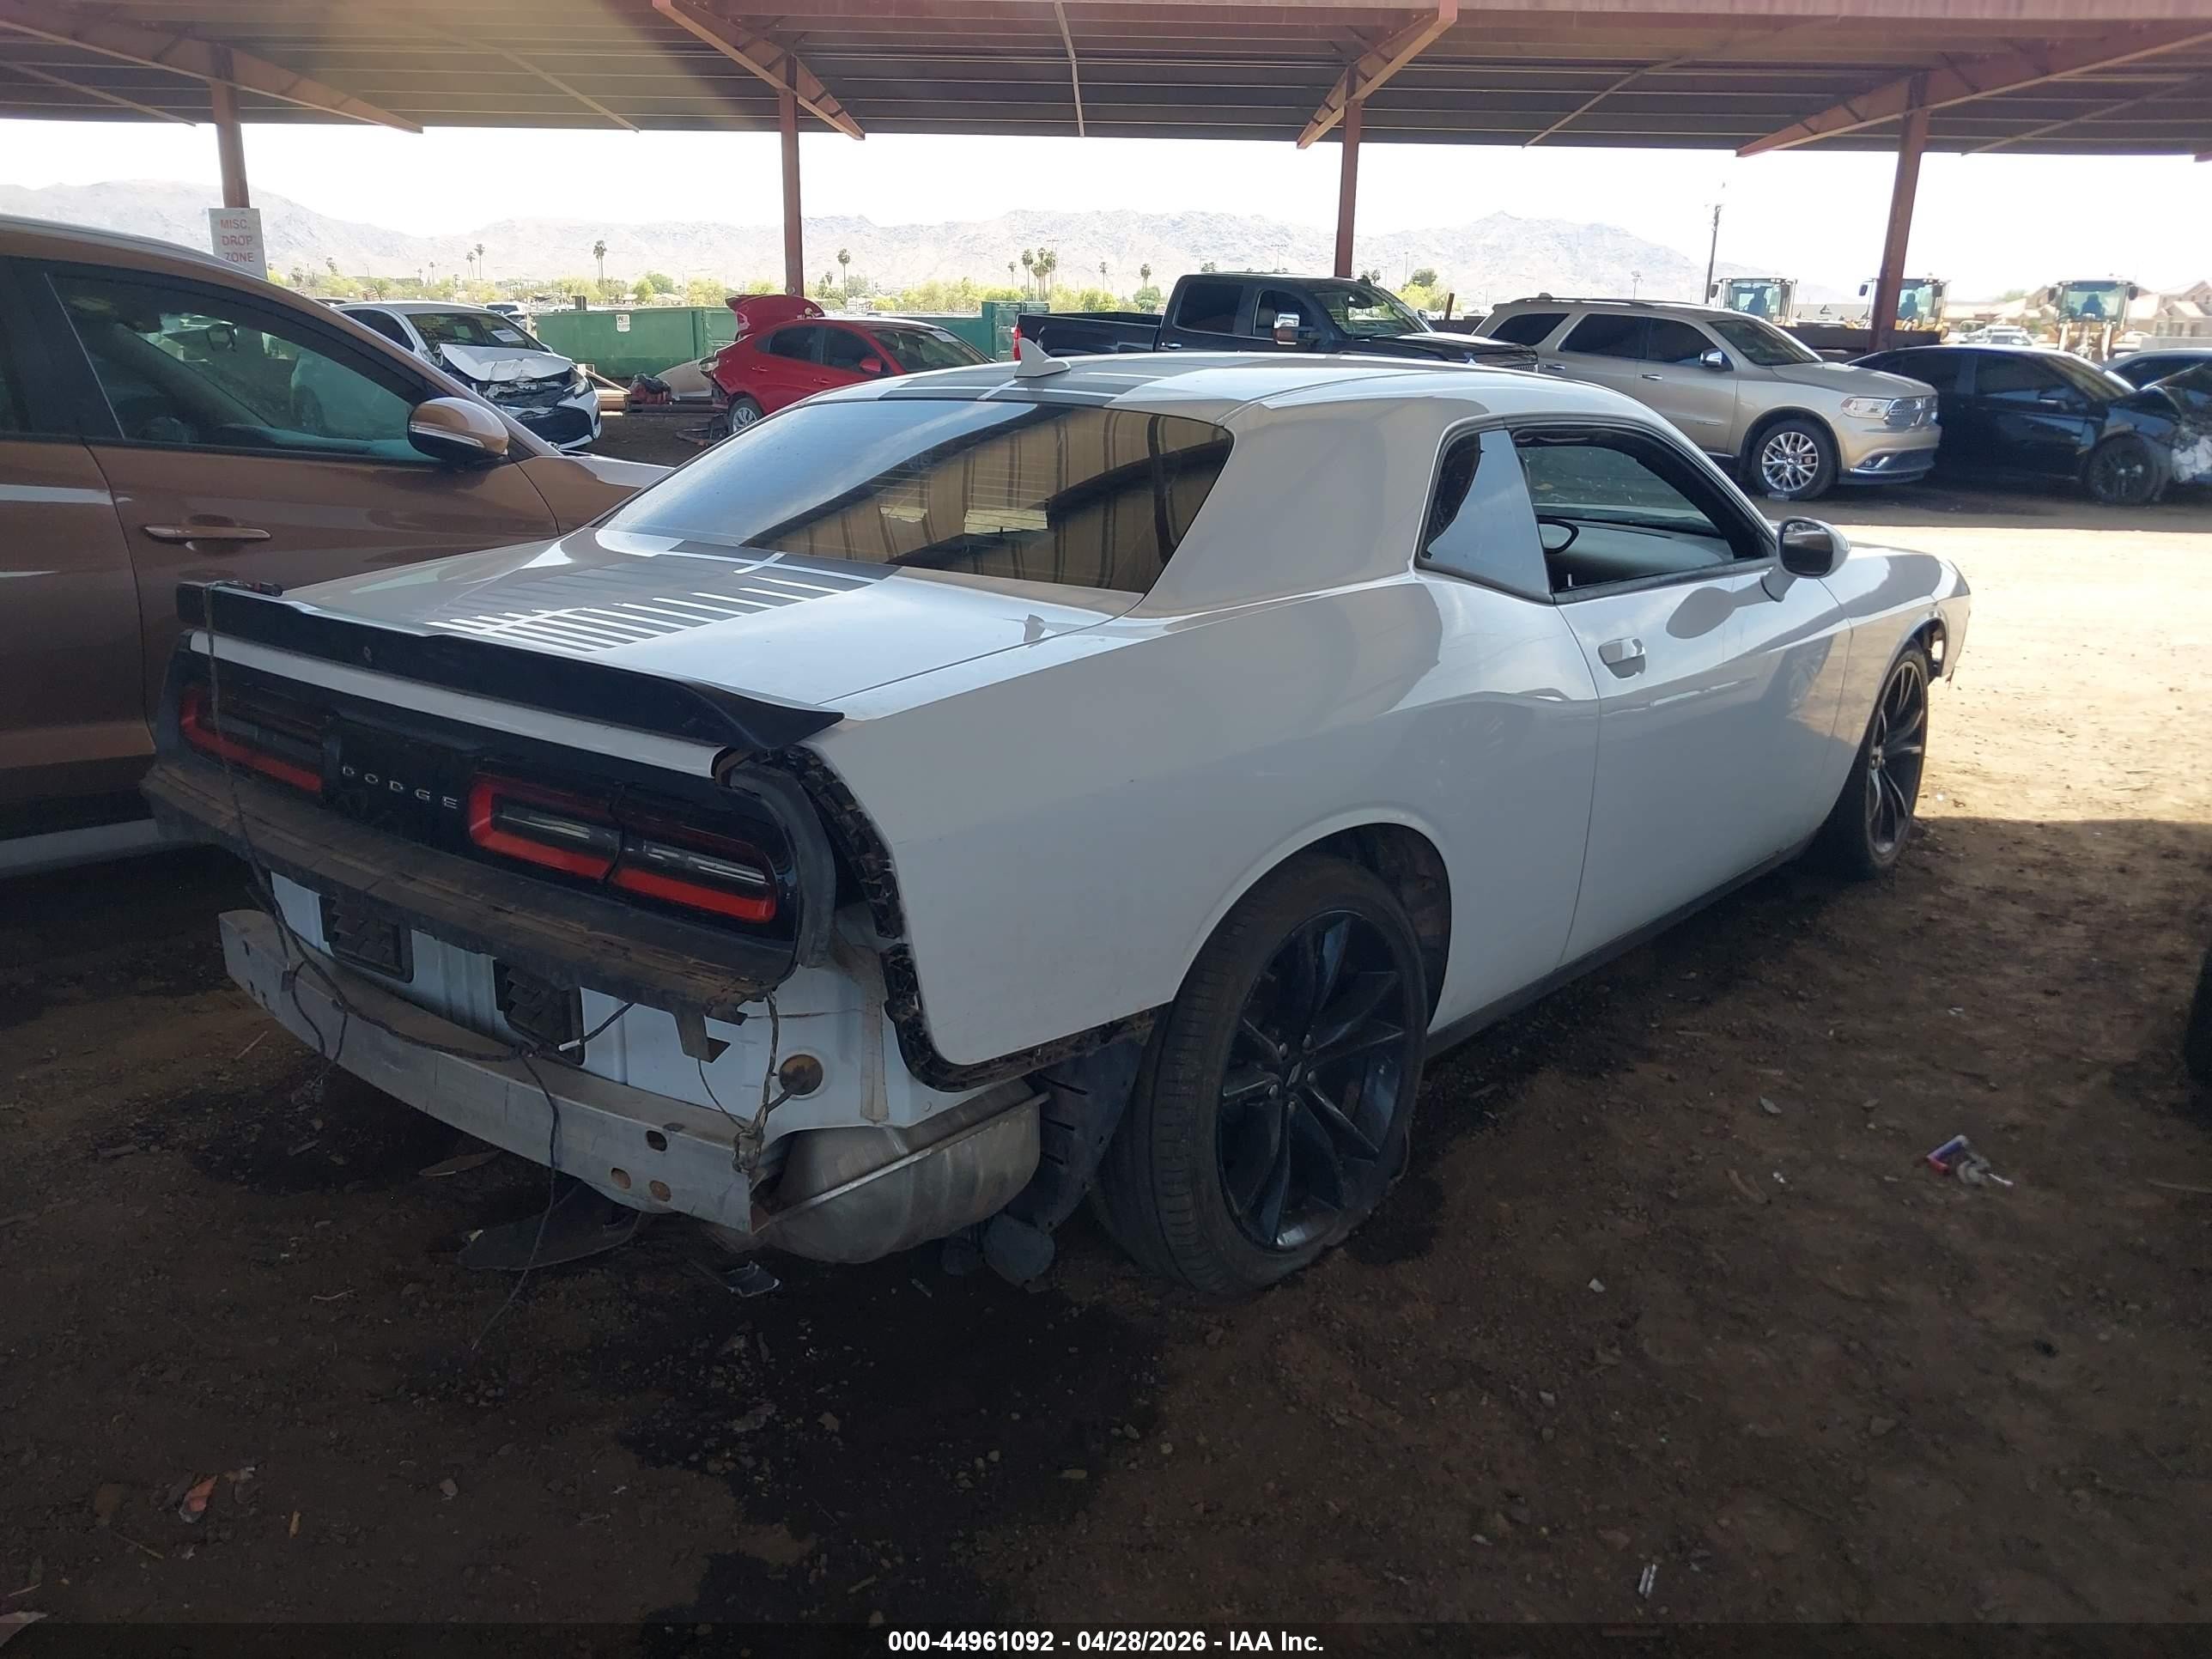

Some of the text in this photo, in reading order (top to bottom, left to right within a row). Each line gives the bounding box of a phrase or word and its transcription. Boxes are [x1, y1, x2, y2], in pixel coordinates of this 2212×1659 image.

[221, 234, 253, 246] DROP
[225, 252, 255, 263] ZONE
[343, 766, 459, 809] DODGE
